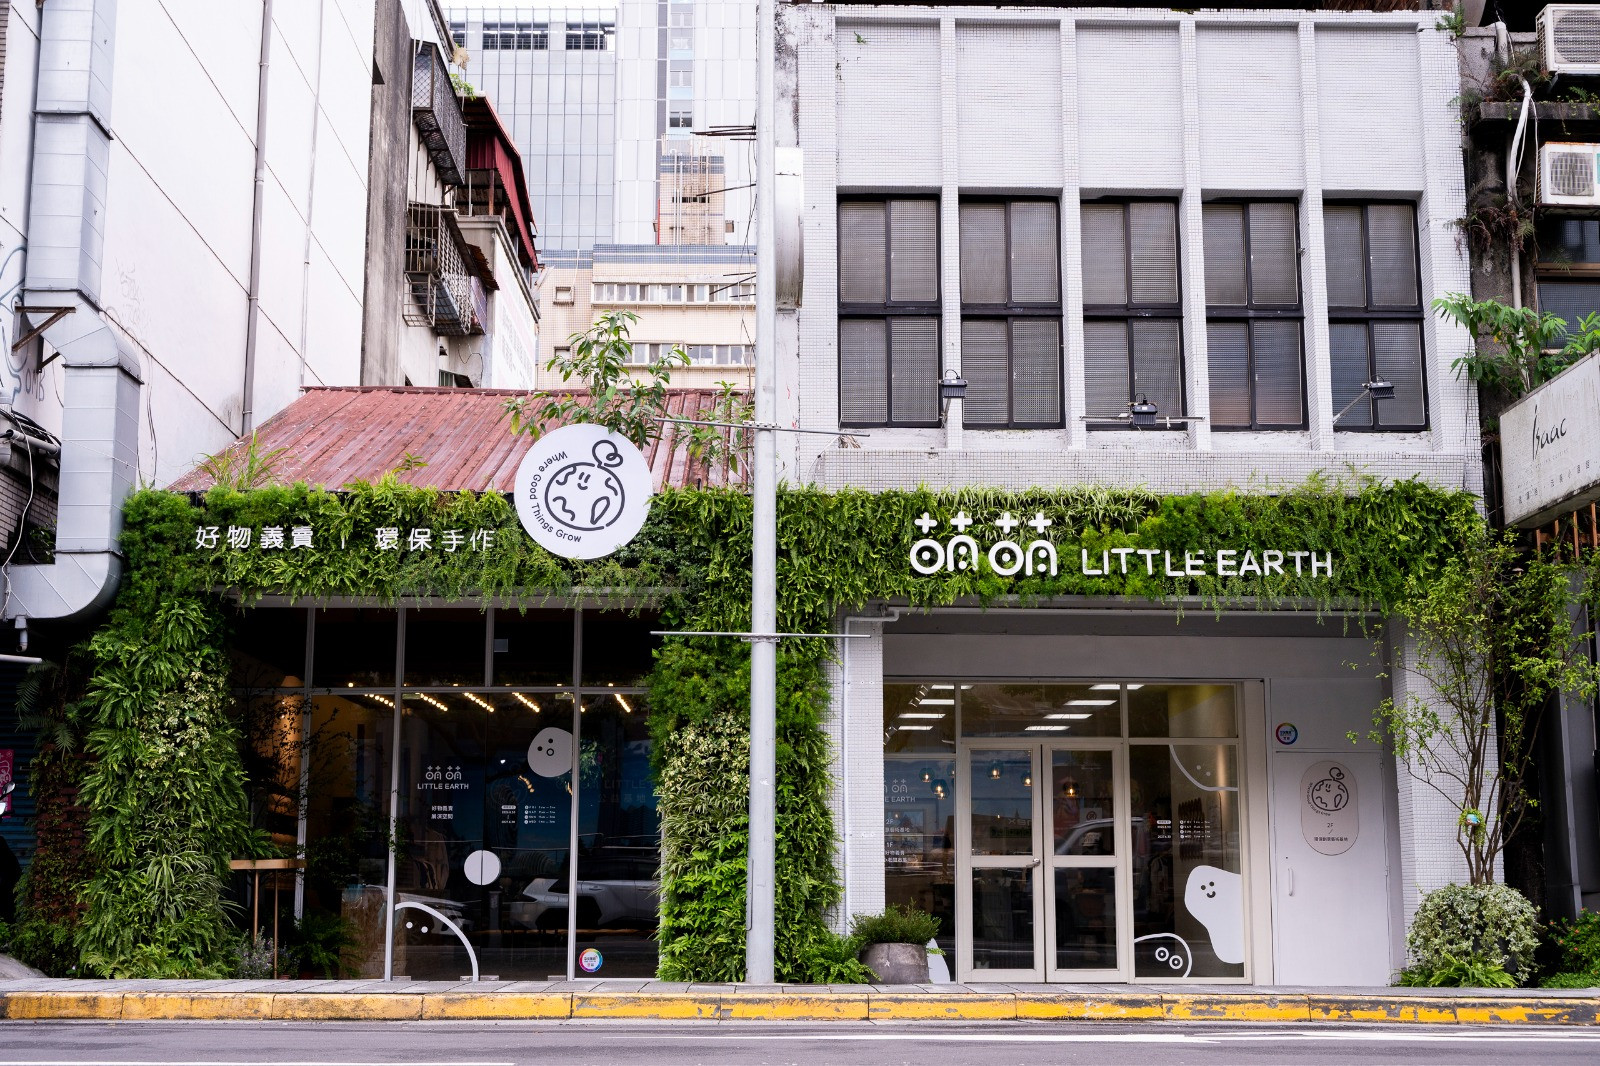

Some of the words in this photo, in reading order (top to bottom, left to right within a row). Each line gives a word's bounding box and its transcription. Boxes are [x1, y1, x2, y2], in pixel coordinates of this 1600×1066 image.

[538, 451, 568, 472] Where
[529, 474, 542, 500] Good
[531, 503, 554, 533] Things
[195, 525, 314, 550] 好物義賣
[375, 527, 496, 552] 環保手作
[555, 529, 582, 543] Grow
[1081, 547, 1206, 577] LITTLE
[1216, 549, 1333, 578] EARTH
